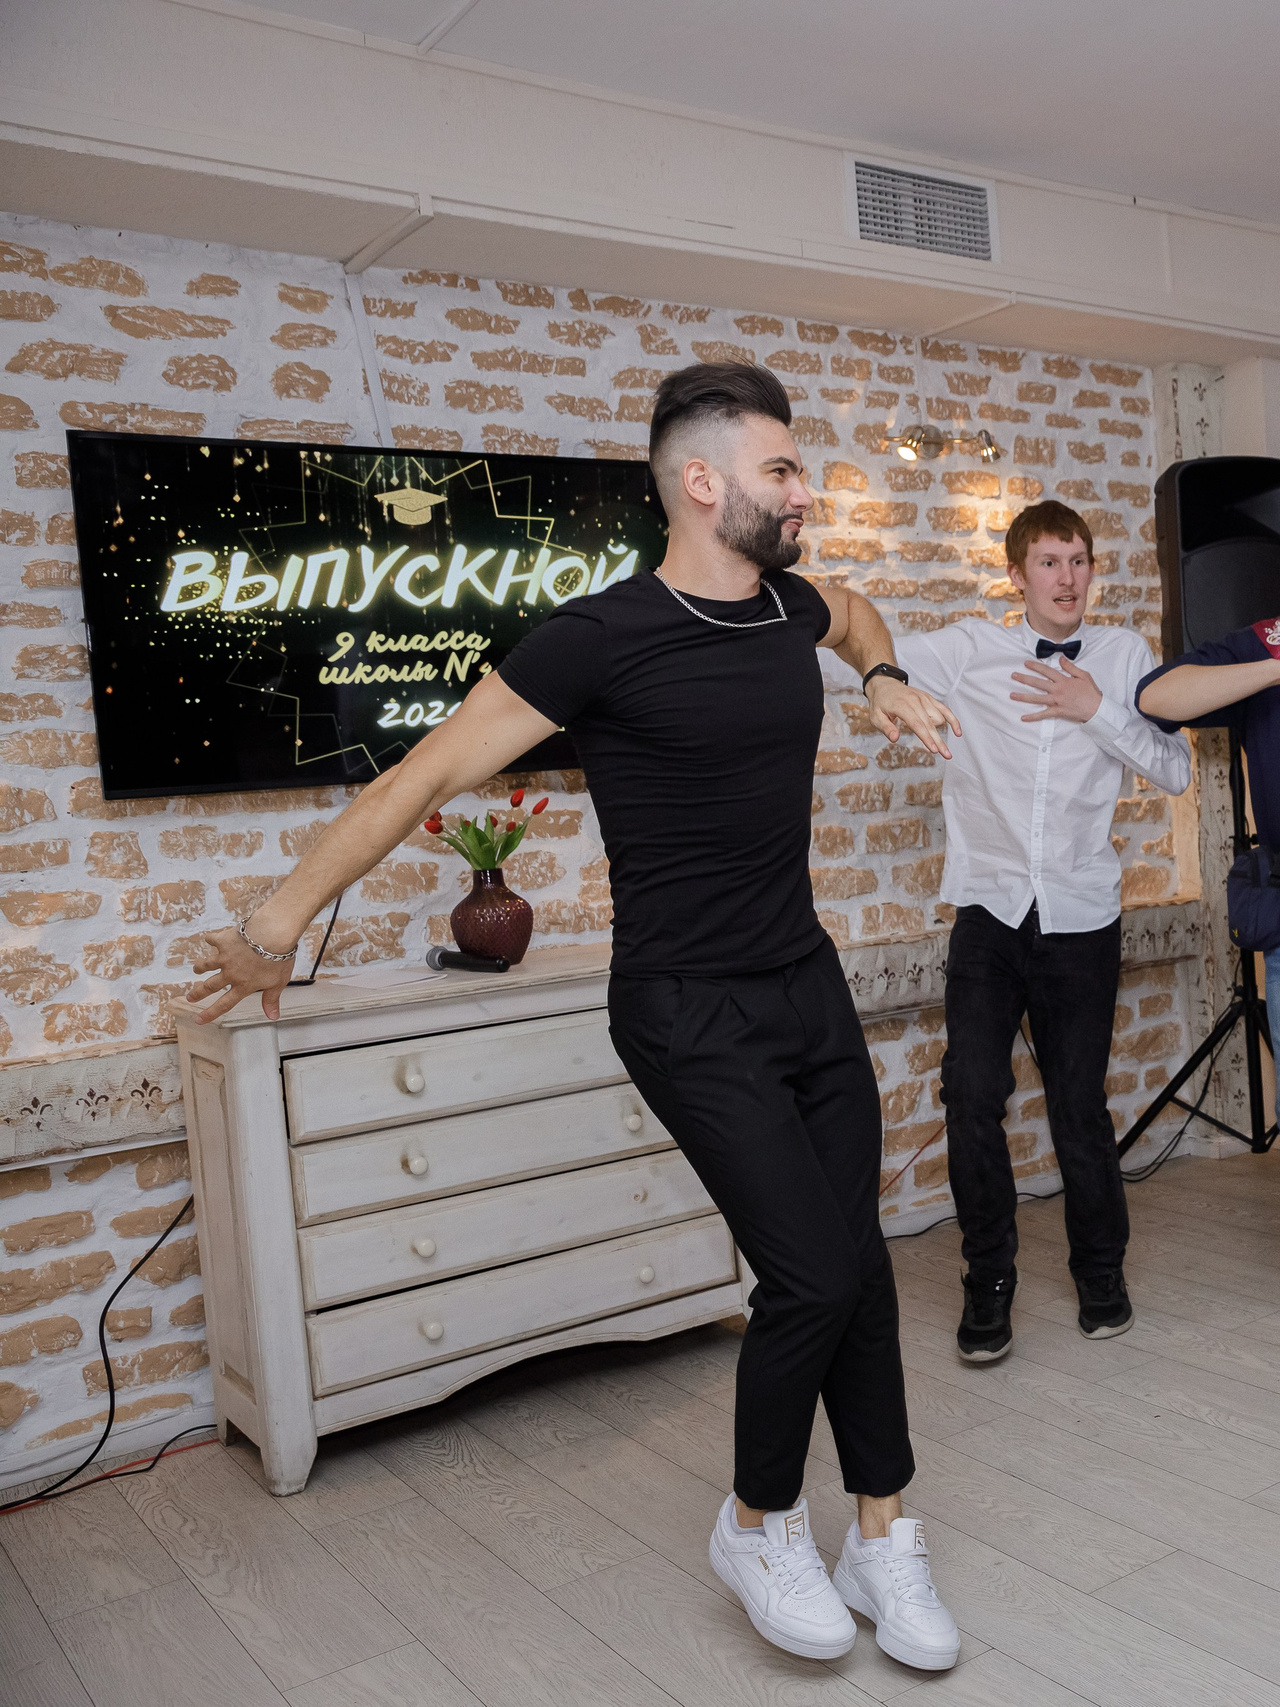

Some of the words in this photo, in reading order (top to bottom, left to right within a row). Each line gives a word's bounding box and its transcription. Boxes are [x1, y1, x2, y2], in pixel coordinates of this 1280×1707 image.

[160, 543, 639, 613] ВЫПУСКНОЙ
[327, 631, 356, 663] 9
[365, 630, 491, 654] класса
[318, 660, 439, 685] школы
